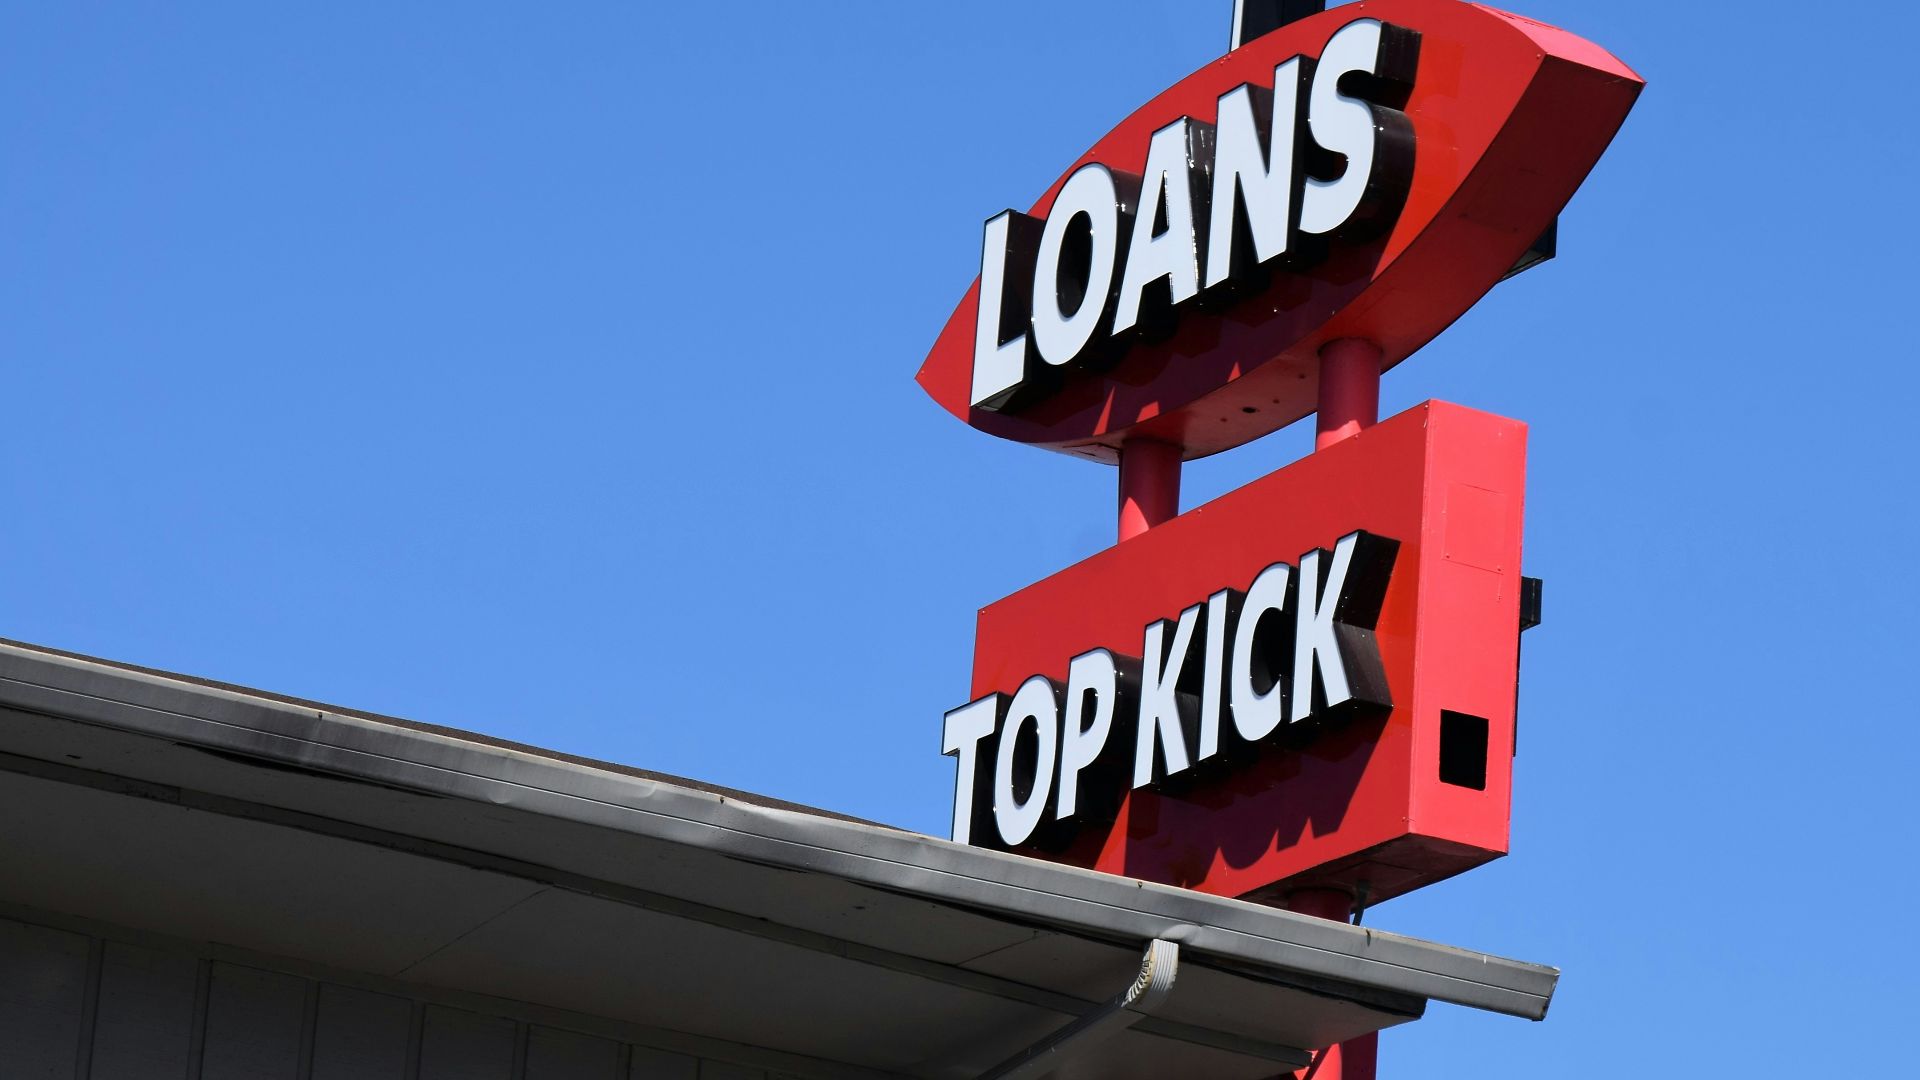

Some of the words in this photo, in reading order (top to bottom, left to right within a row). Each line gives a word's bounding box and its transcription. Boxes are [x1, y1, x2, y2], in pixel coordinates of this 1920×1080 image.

[970, 16, 1383, 408] LOANS
[941, 646, 1117, 847] TOP
[1132, 530, 1360, 790] KICK
